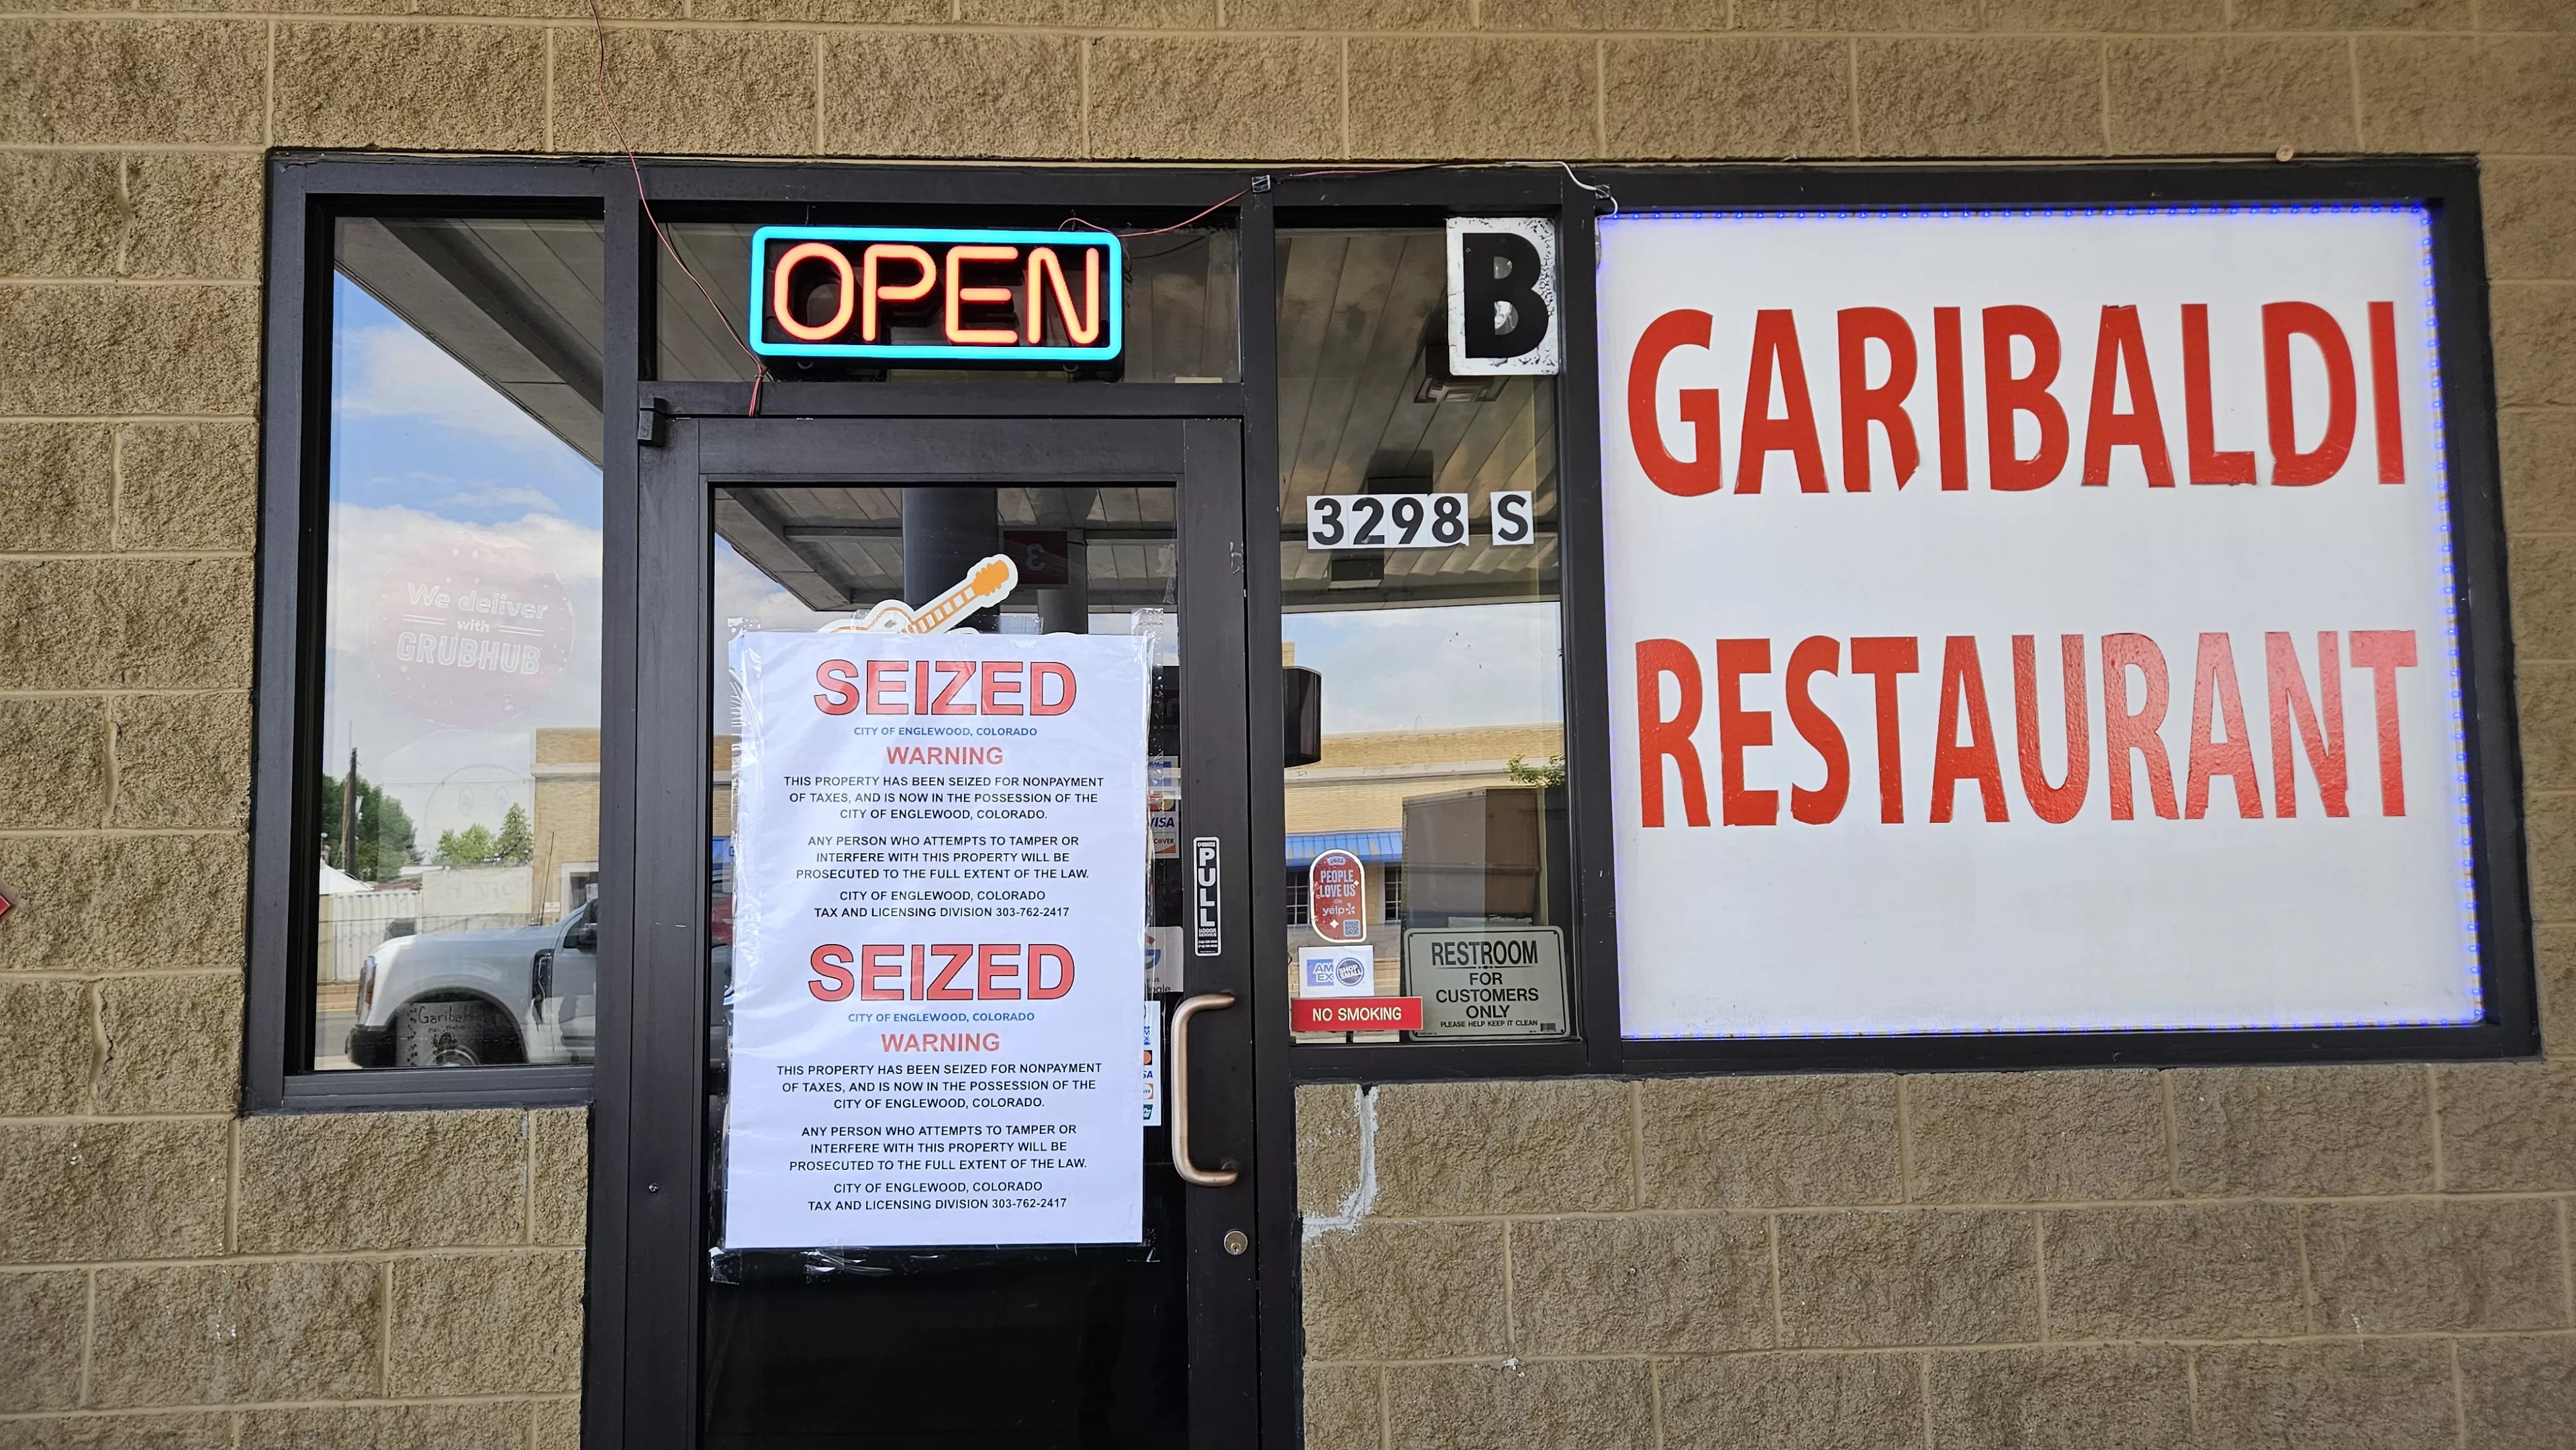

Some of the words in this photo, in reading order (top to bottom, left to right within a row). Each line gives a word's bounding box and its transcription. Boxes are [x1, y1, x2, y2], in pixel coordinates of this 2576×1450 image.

[773, 242, 1099, 344] OPEN
[1463, 233, 1549, 358] B
[1627, 300, 2405, 497] GARIBALDI
[1312, 496, 1464, 546] 3298
[1497, 494, 1528, 542] S
[408, 583, 450, 608] We
[458, 590, 548, 619] deliver
[457, 619, 490, 634] with
[396, 631, 542, 675] GRUBHUB
[813, 659, 1078, 716] SEIZED
[853, 727, 879, 736] CITY
[881, 727, 896, 735] OF
[898, 727, 973, 737] ENGLEWOOD,
[976, 727, 1037, 736] COLORADO
[1635, 629, 2418, 828] RESTAURANT
[886, 746, 1003, 765] WARNING
[783, 776, 812, 786] THIS
[815, 776, 880, 786] PROPERTY
[883, 776, 908, 786] HAS
[912, 777, 945, 786] BEEN
[948, 777, 991, 786] SEIZED
[995, 777, 1020, 786] FOR
[1022, 777, 1104, 787] NONPAYMENT
[789, 792, 806, 803] OF
[810, 793, 851, 804] TAXES,
[855, 793, 881, 802] AND
[884, 792, 896, 803] IS
[899, 793, 928, 803] NOW
[932, 793, 943, 803] IN
[946, 793, 971, 803] THE
[974, 793, 1051, 803] POSSESSION
[1055, 793, 1071, 803] OF
[1074, 793, 1098, 803] THE
[840, 809, 867, 819] CITY
[870, 809, 888, 819] OF
[890, 809, 973, 821] ENGLEWOOD,
[977, 809, 1047, 819] COLORADO.
[808, 836, 833, 846] ANY
[836, 836, 887, 846] PERSON
[890, 836, 920, 846] WHO
[922, 836, 987, 847] ATTEMPTS
[989, 836, 1006, 846] TO
[1008, 836, 1058, 846] TAMPER
[1061, 836, 1079, 846] OR
[816, 853, 885, 863] INTERFERE
[888, 853, 919, 863] WITH
[922, 853, 950, 863] THIS
[953, 853, 1018, 863] PROPERTY
[1020, 853, 1050, 862] WILL
[1053, 853, 1069, 862] BE
[796, 869, 879, 879] PROSECUTED
[882, 869, 899, 879] TO
[902, 869, 926, 879] THE
[930, 869, 961, 879] FULL
[964, 869, 1011, 879] EXTENT
[1014, 869, 1031, 879] OF
[1033, 869, 1057, 879] THE
[1061, 869, 1089, 879] LAW.
[1320, 869, 1354, 883] PEOPLE
[1198, 847, 1216, 927] PULL
[1319, 884, 1342, 898] LOVE
[1343, 883, 1356, 897] US
[840, 891, 867, 901] CITY
[871, 891, 888, 901] OF
[891, 890, 973, 902] ENGLEWOOD,
[977, 890, 1046, 901] COLORADO
[814, 907, 838, 918] TAX
[841, 907, 867, 918] AND
[871, 907, 937, 917] LICENSING
[940, 907, 992, 917] DIVISION
[996, 907, 1069, 917] 303-762-2417
[1322, 906, 1345, 916] yelp
[1431, 940, 1538, 965] RESTROOM
[808, 943, 1076, 1002] SEIZED
[1314, 963, 1334, 973] AM
[1339, 964, 1357, 974] SHOP
[1339, 969, 1362, 979] SMALL
[1317, 973, 1334, 982] EX
[1470, 972, 1503, 985] FOR
[1436, 987, 1539, 1003] CUSTOMERS
[848, 1014, 873, 1022] CITY
[875, 1013, 891, 1022] OF
[894, 1012, 969, 1023] ENGLEWOOD,
[972, 1012, 1035, 1022] COLORADO
[1313, 1008, 1333, 1022] NO
[1337, 1007, 1402, 1021] SMOKING
[1466, 1005, 1510, 1018] ONLY
[881, 1032, 1000, 1053] WARNING
[776, 1065, 804, 1075] THIS
[808, 1065, 875, 1075] PROPERTY
[877, 1065, 903, 1075] HAS
[906, 1064, 940, 1075] BEEN
[943, 1064, 988, 1075] SEIZED
[991, 1063, 1016, 1074] FOR
[1020, 1063, 1102, 1073] NONPAYMENT
[782, 1082, 799, 1092] OF
[802, 1082, 845, 1094] TAXES,
[849, 1082, 875, 1092] AND
[879, 1081, 890, 1092] IS
[894, 1081, 924, 1092] NOW
[926, 1081, 939, 1092] IN
[942, 1081, 966, 1092] THE
[969, 1080, 1049, 1091] POSSESSION
[1052, 1079, 1069, 1090] OF
[1071, 1079, 1096, 1090] THE
[833, 1098, 862, 1109] CITY
[865, 1098, 882, 1109] OF
[885, 1098, 969, 1110] ENGLEWOOD,
[972, 1097, 1045, 1108] COLORADO.
[801, 1126, 828, 1137] ANY
[830, 1126, 881, 1137] PERSON
[885, 1126, 915, 1136] WHO
[918, 1125, 983, 1136] ATTEMPTS
[986, 1125, 1002, 1135] TO
[1005, 1124, 1055, 1135] TAMPER
[1059, 1124, 1077, 1134] OR
[810, 1143, 879, 1154] INTERFERE
[883, 1143, 914, 1153] WITH
[917, 1143, 945, 1153] THIS
[948, 1142, 1015, 1153] PROPERTY
[1017, 1141, 1047, 1152] WILL
[1051, 1141, 1067, 1151] BE
[789, 1160, 874, 1171] PROSECUTED
[877, 1160, 894, 1170] TO
[897, 1159, 922, 1170] THE
[924, 1159, 956, 1170] FULL
[959, 1159, 1008, 1170] EXTENT
[1010, 1159, 1027, 1169] OF
[1030, 1158, 1055, 1169] THE
[1058, 1158, 1087, 1169] LAW.
[833, 1183, 862, 1194] CITY
[865, 1183, 882, 1194] OF
[886, 1182, 969, 1194] ENGLEWOOD,
[972, 1181, 1043, 1192] COLORADO
[808, 1201, 832, 1211] TAX
[834, 1200, 862, 1211] AND
[865, 1200, 931, 1210] LICENSING
[935, 1198, 988, 1209] DIVISION
[992, 1198, 1067, 1208] 303-762-2417
